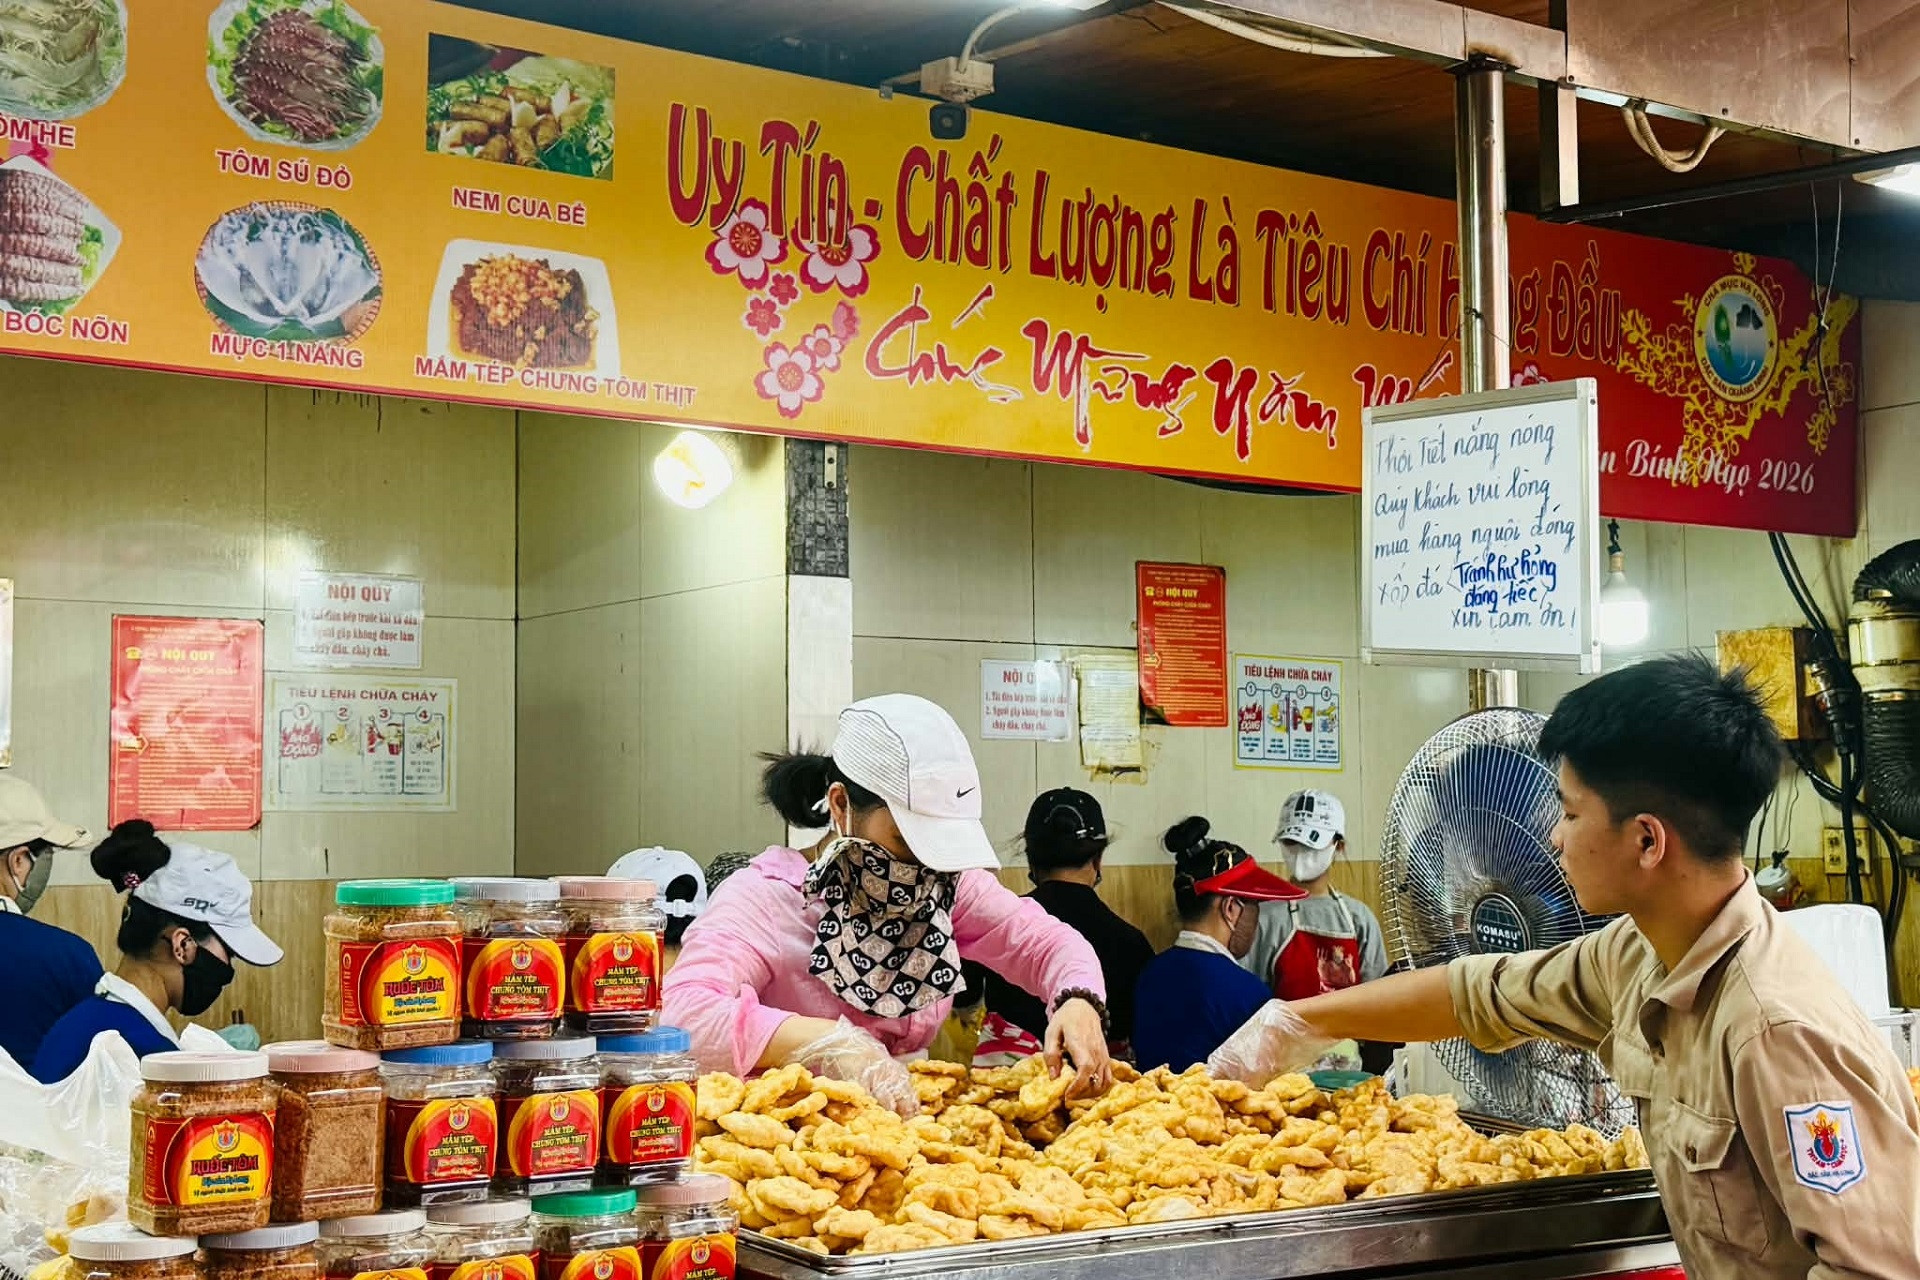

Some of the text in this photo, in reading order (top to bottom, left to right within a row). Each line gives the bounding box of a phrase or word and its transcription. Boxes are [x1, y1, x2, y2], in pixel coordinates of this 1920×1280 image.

[39, 127, 75, 147] HE
[217, 150, 270, 176] TÔM
[278, 159, 309, 182] SÚ
[453, 188, 499, 211] NEM
[507, 196, 551, 219] CUA
[668, 102, 745, 230] Uy
[759, 119, 848, 247] Tín
[896, 132, 1017, 273] Chất
[1029, 169, 1178, 314] Lượng
[1188, 195, 1240, 307] Là
[1255, 209, 1350, 325] Tiêu
[1362, 227, 1431, 337] Chí
[1546, 239, 1621, 365] Đầu
[5, 309, 128, 343] BÓC NÕN
[212, 333, 268, 360] MỰC
[277, 342, 286, 360] 1
[473, 360, 515, 384] TÉP
[520, 369, 597, 392] CHƯNG
[602, 375, 647, 399] TÔM
[653, 383, 696, 408] THỊT
[864, 284, 1022, 404] Chúc
[1203, 356, 1337, 463] Năm
[1626, 438, 1688, 483] Bính
[1758, 458, 1815, 494] 2026
[1469, 482, 1501, 505] vui
[1375, 538, 1410, 559] mua
[1418, 521, 1462, 562] hàng
[1003, 668, 1022, 686] NỘI
[338, 707, 347, 717] 2
[379, 708, 388, 718] 3
[418, 709, 428, 719] 4
